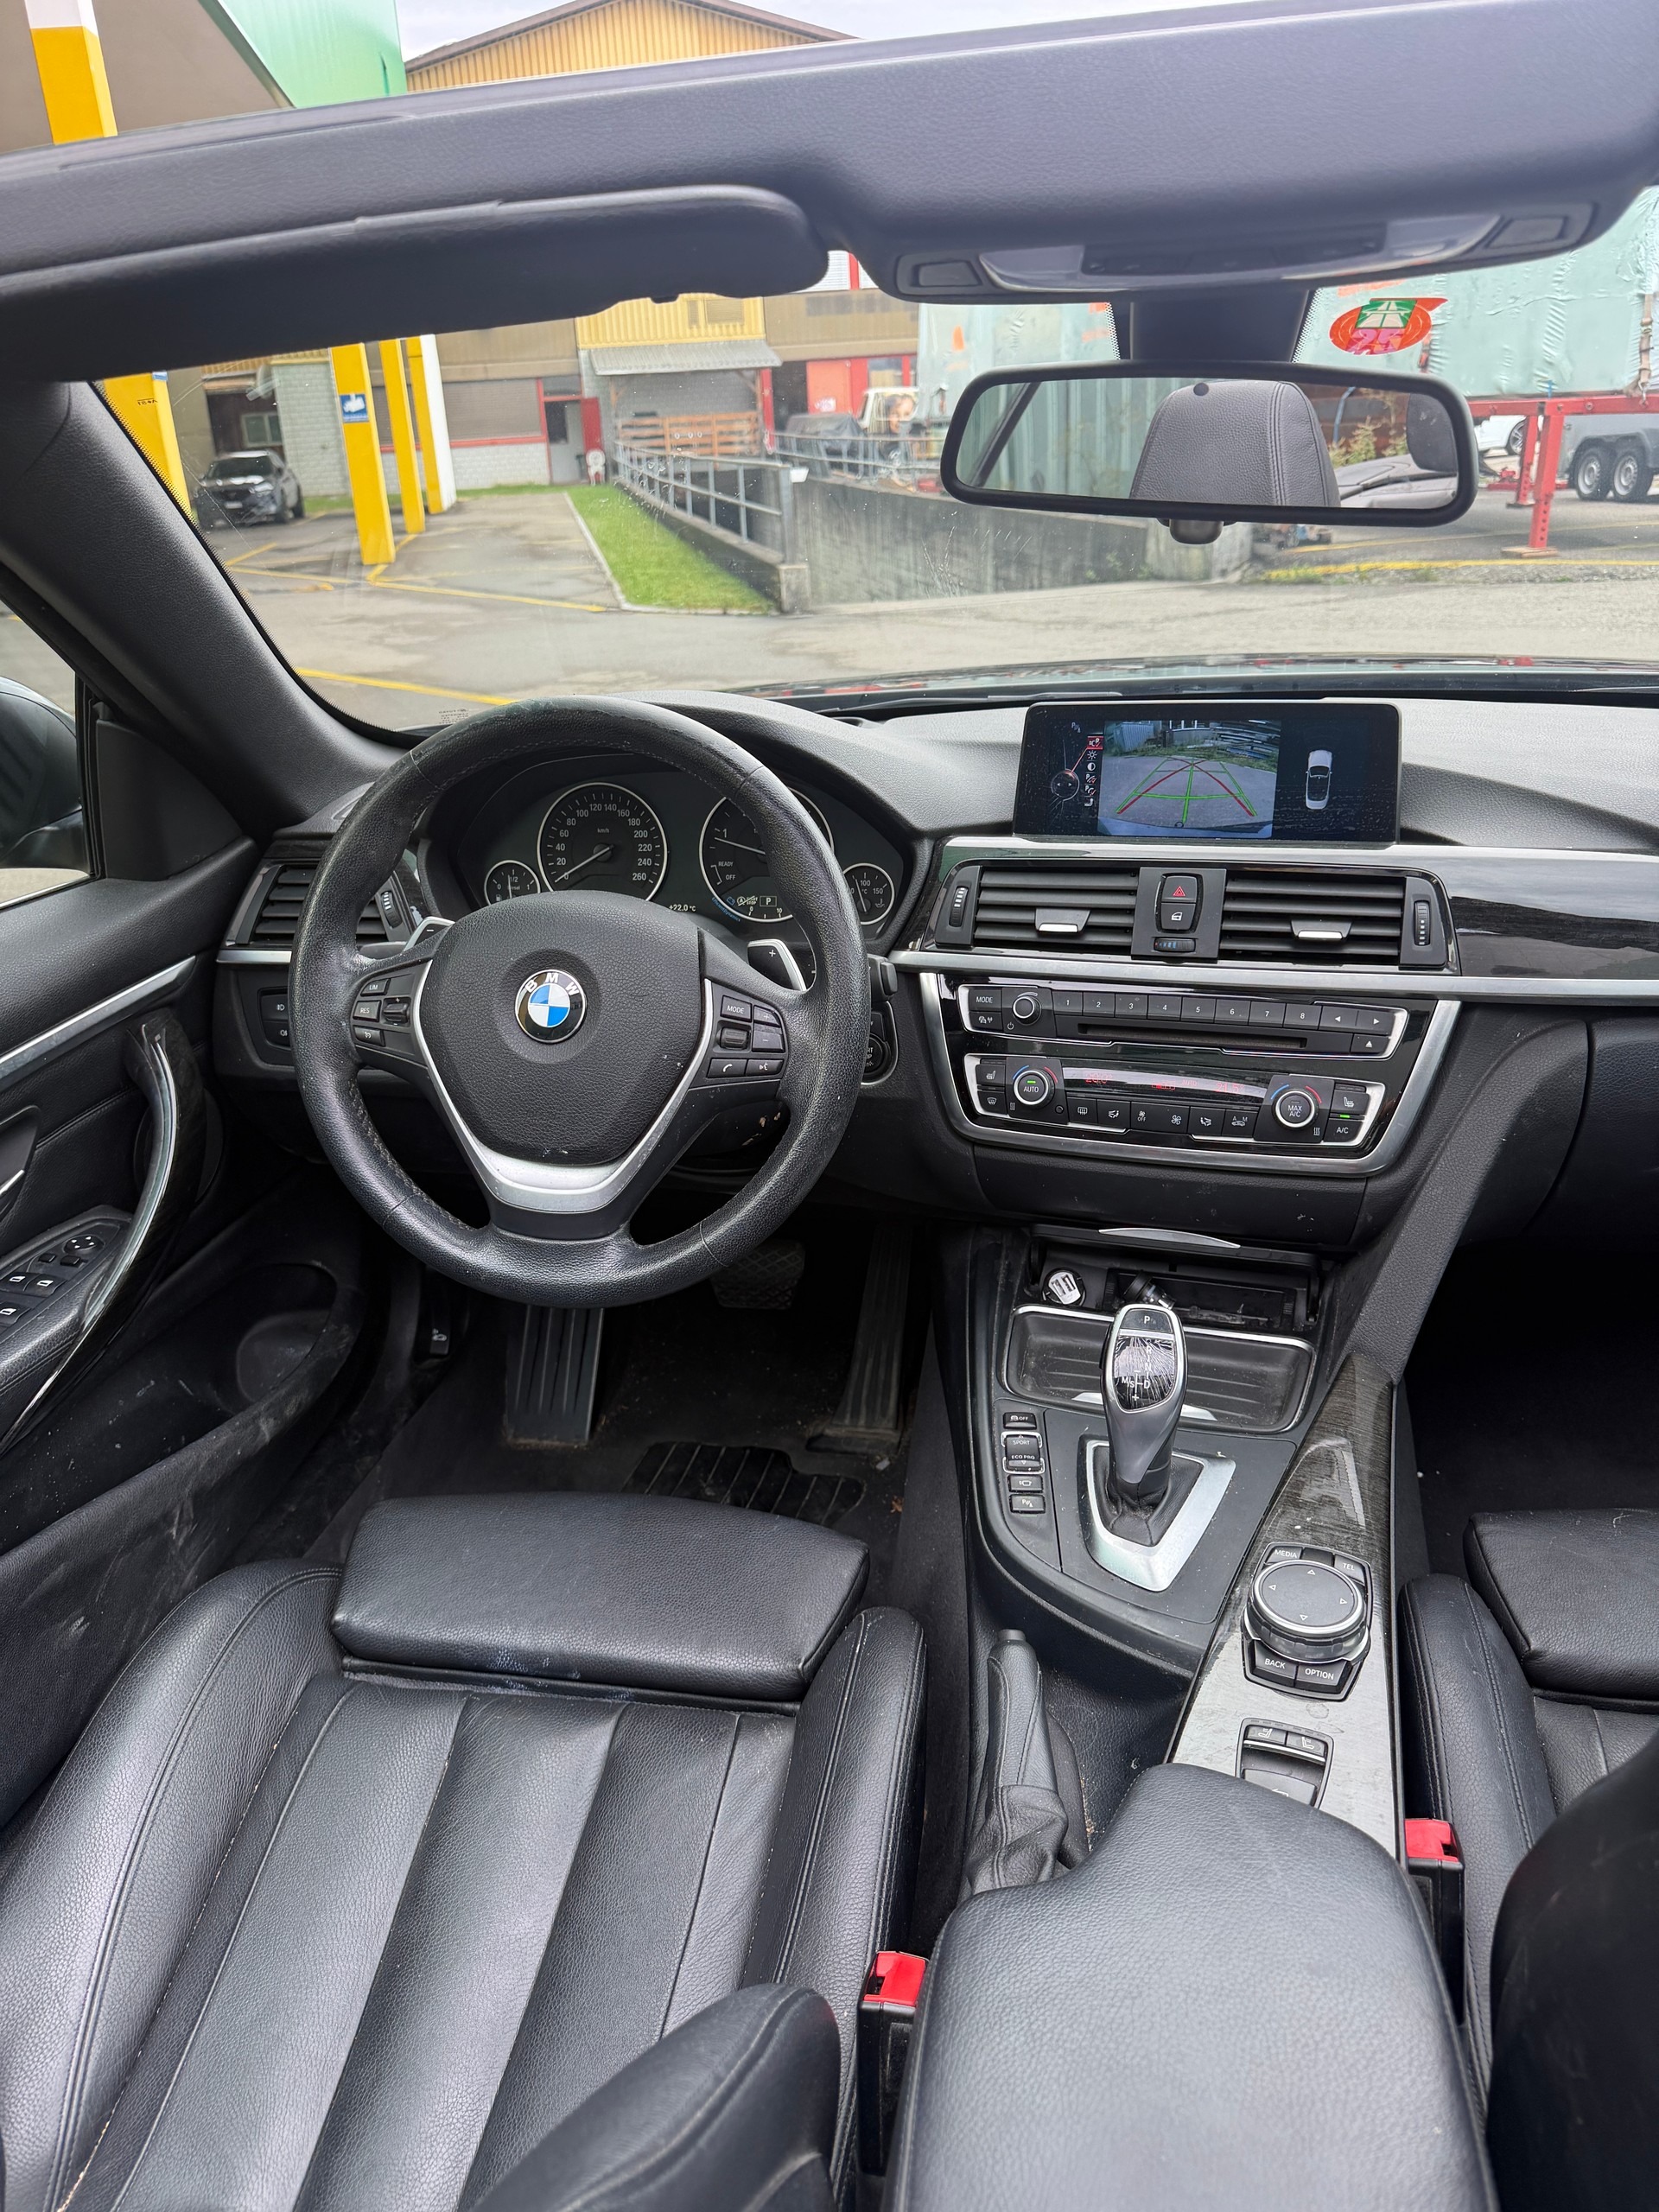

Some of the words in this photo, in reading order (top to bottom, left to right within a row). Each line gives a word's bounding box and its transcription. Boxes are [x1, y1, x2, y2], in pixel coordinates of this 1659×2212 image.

[524, 972, 580, 996] BMW
[976, 995, 994, 1004] MODE
[727, 1005, 745, 1014] MODE
[1143, 1380, 1151, 1389] D
[1274, 1549, 1298, 1559] MEDIA
[1342, 1562, 1355, 1571] TEL
[1264, 1658, 1286, 1669] BACK
[1305, 1669, 1334, 1680] OPTION
